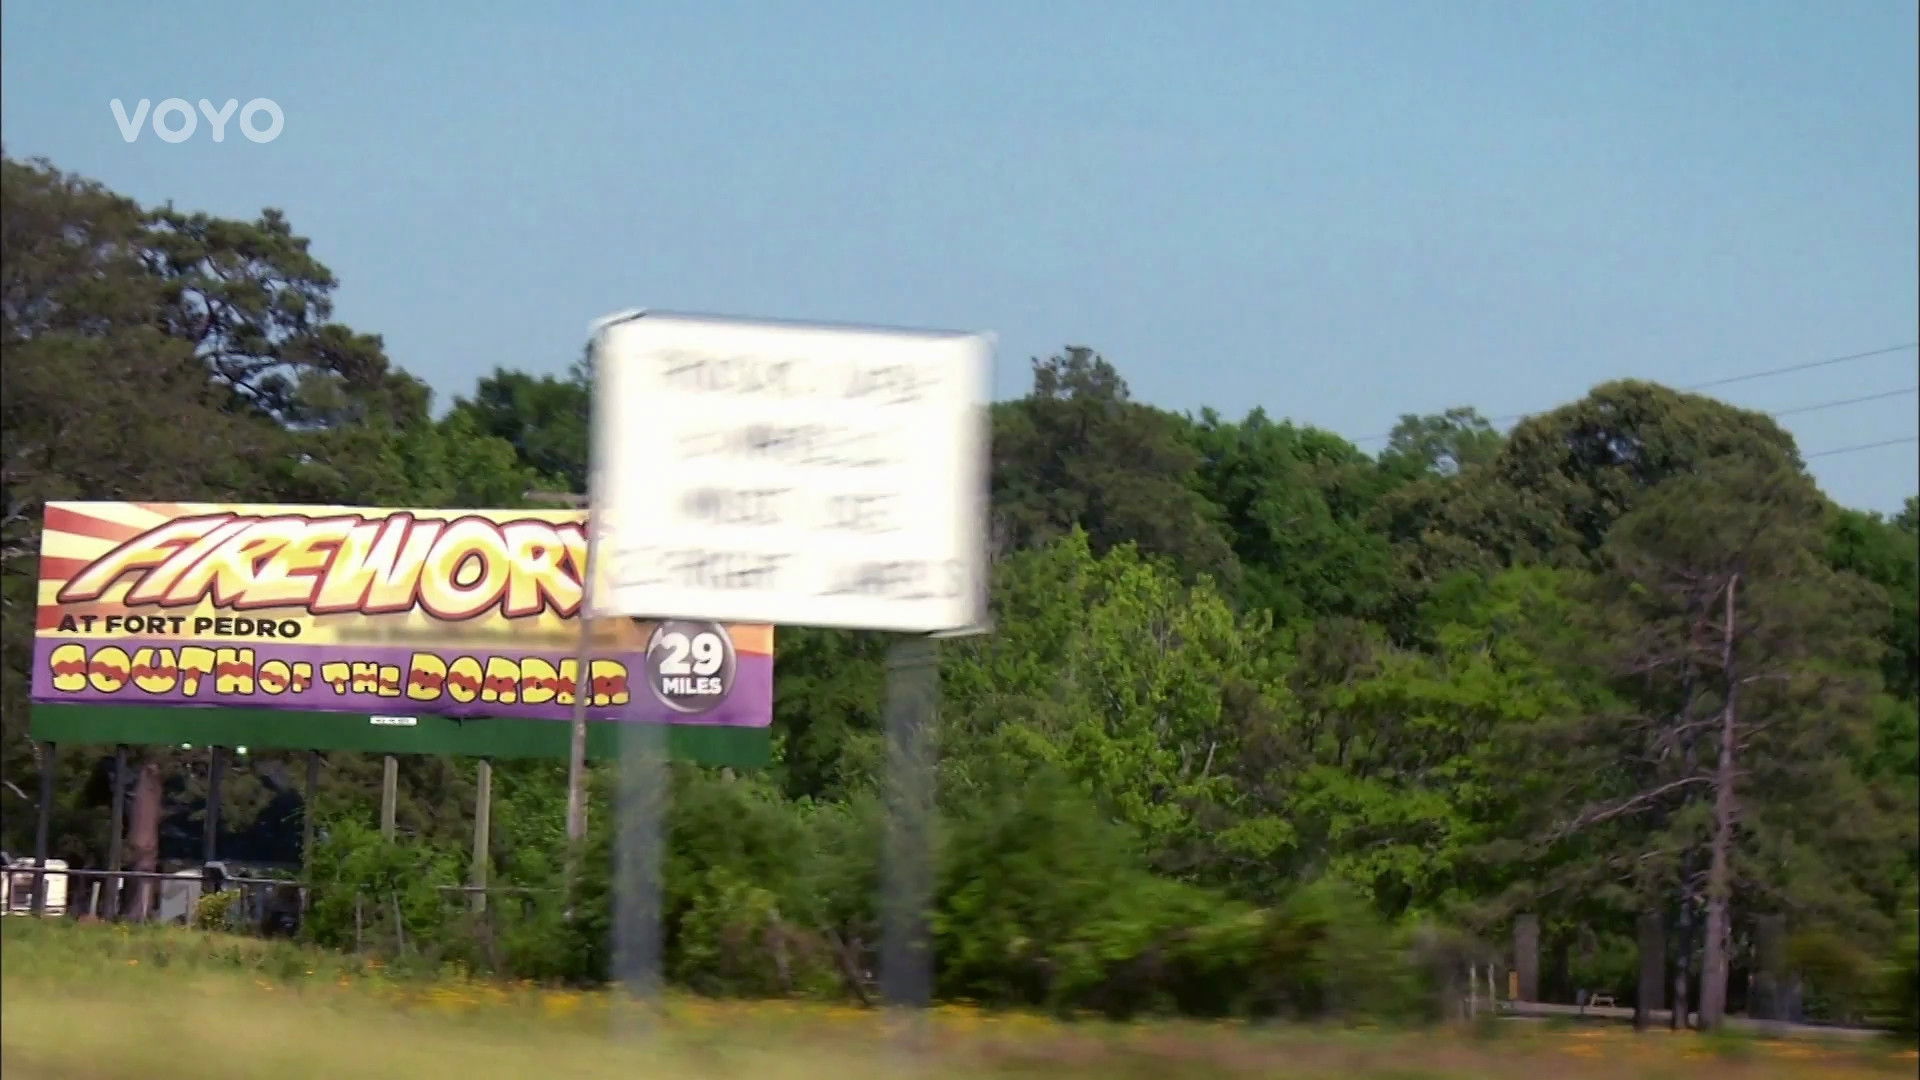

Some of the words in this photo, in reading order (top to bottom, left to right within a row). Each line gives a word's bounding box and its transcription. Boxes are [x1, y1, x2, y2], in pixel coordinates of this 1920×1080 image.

[57, 614, 97, 633] AT
[105, 615, 186, 635] FORT
[194, 617, 301, 638] PEDRO
[50, 643, 255, 697] SOUTH
[659, 633, 723, 675] 29
[663, 677, 722, 695] MILES
